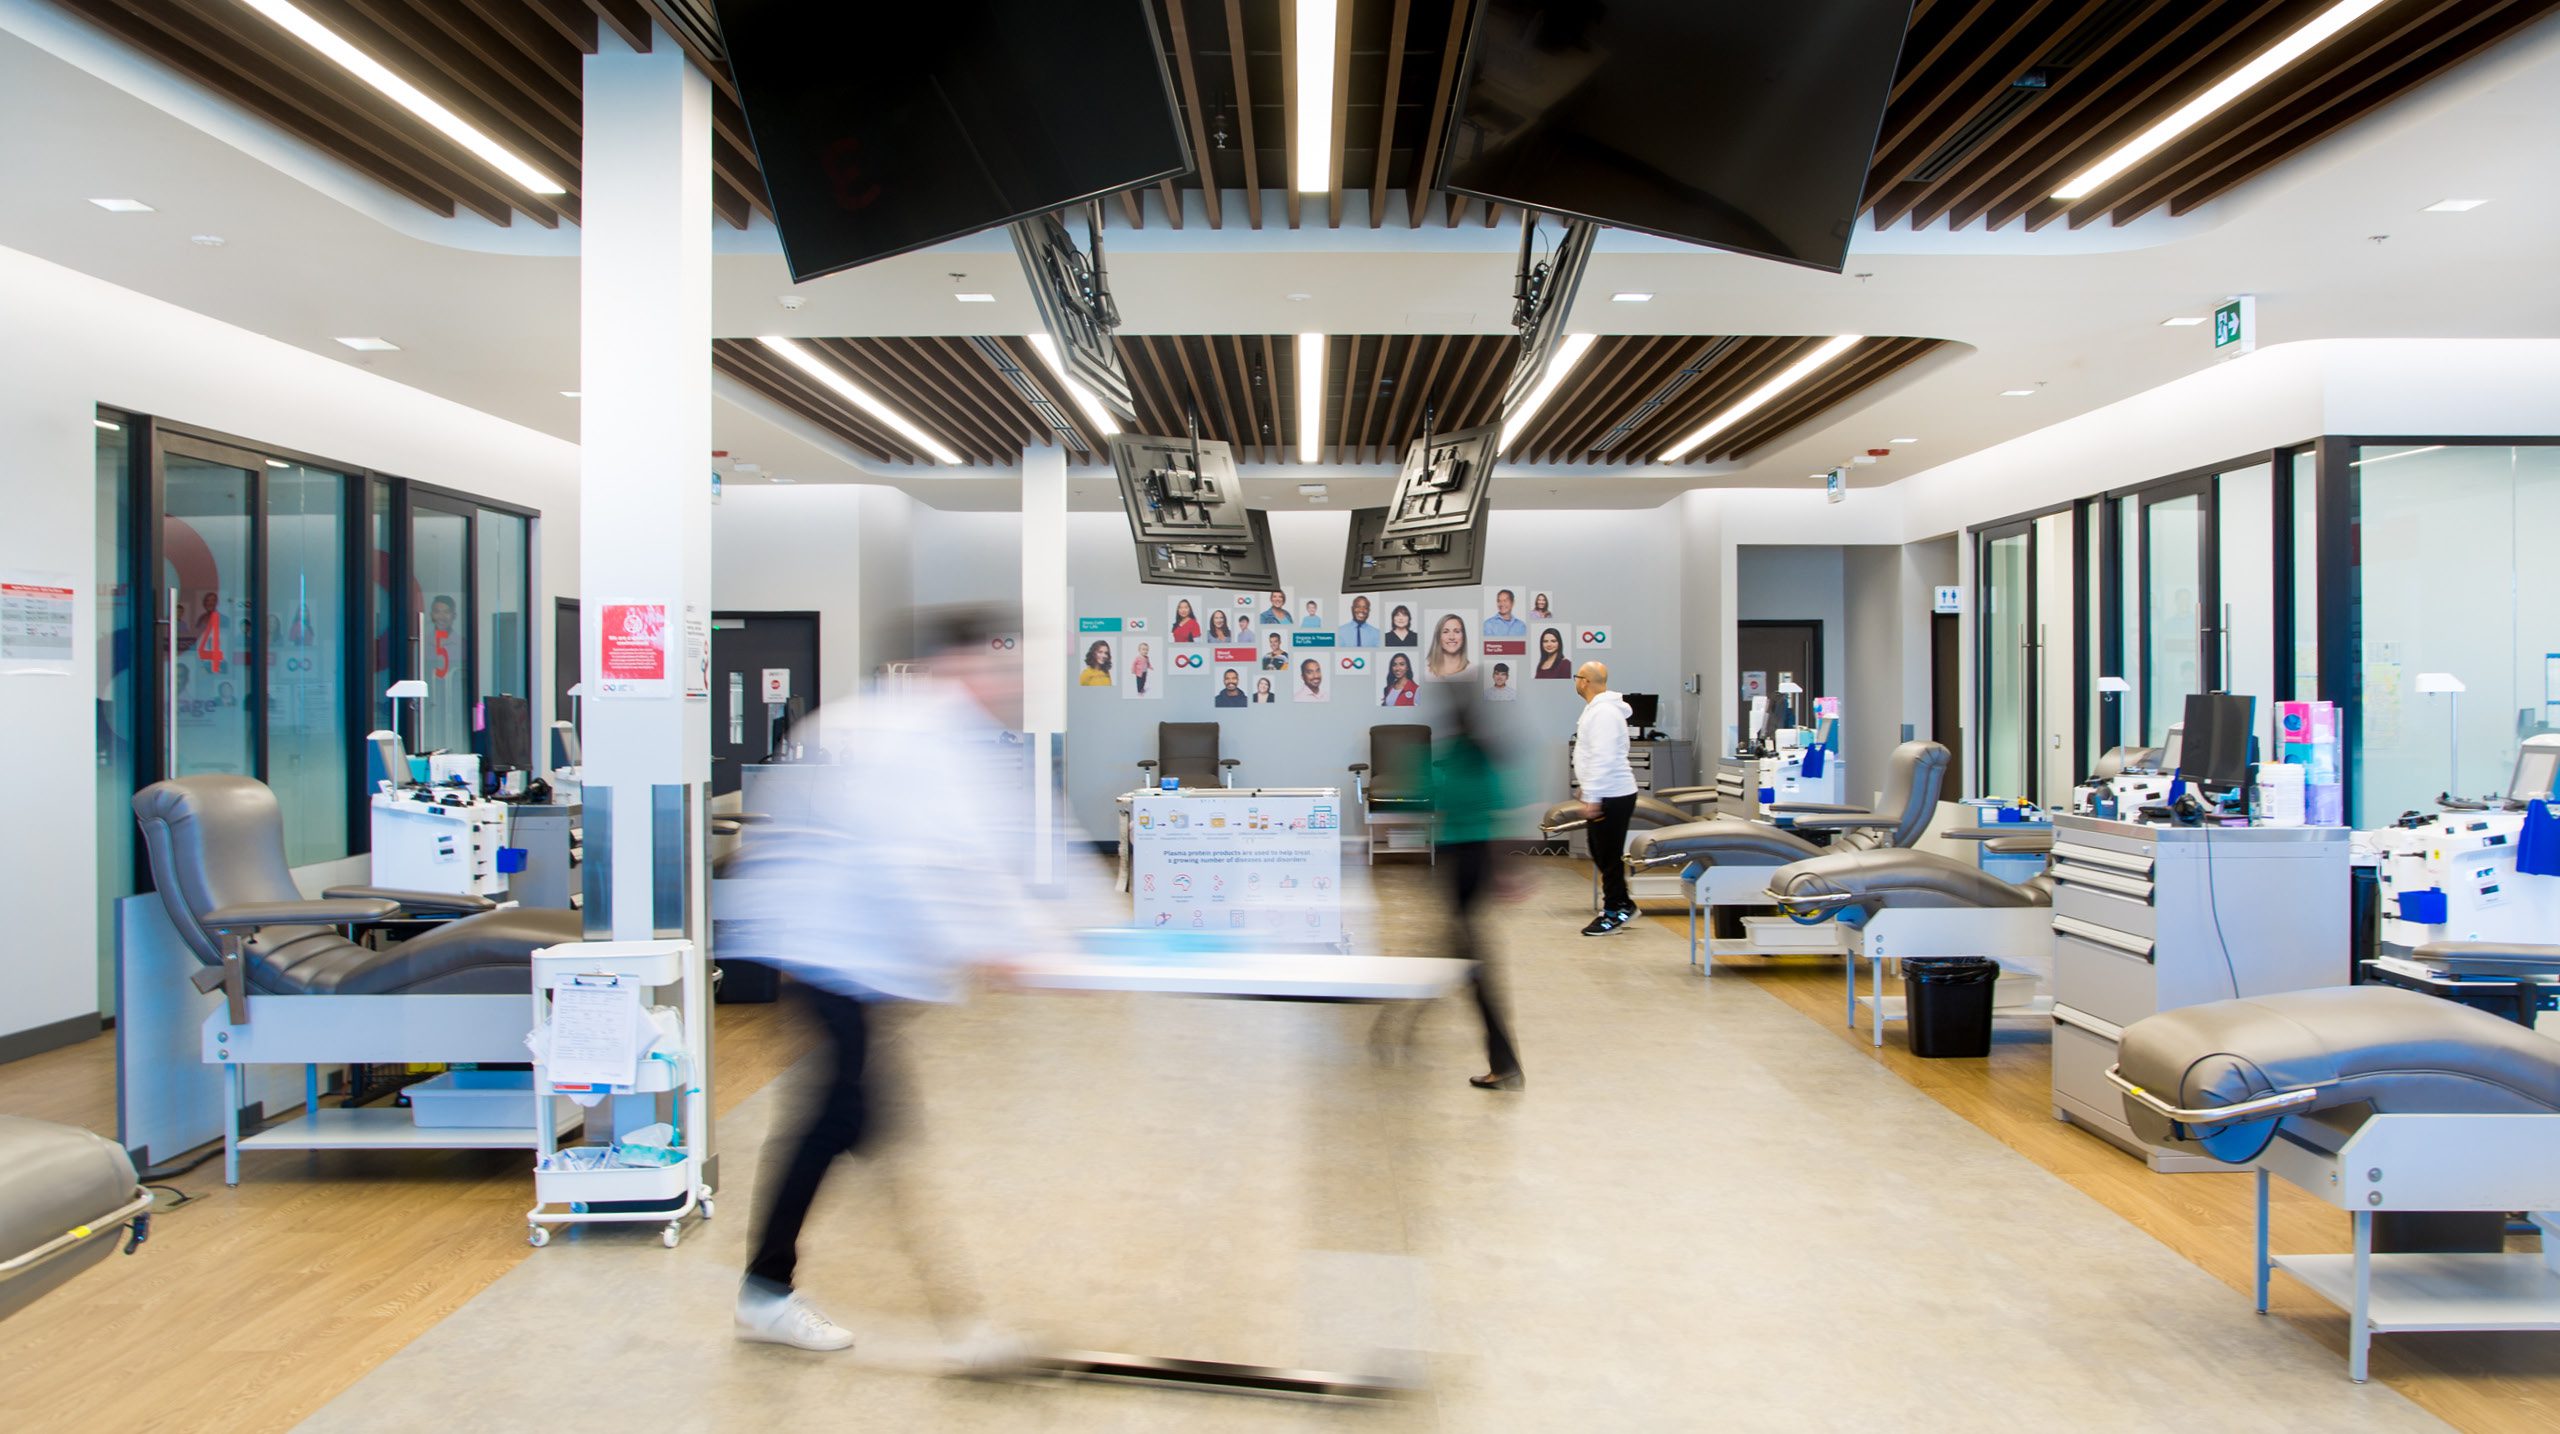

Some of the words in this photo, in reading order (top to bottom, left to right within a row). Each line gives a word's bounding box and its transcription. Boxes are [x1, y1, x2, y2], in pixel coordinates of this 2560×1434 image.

[197, 611, 224, 673] 4
[434, 629, 450, 679] 5
[179, 699, 217, 717] age
